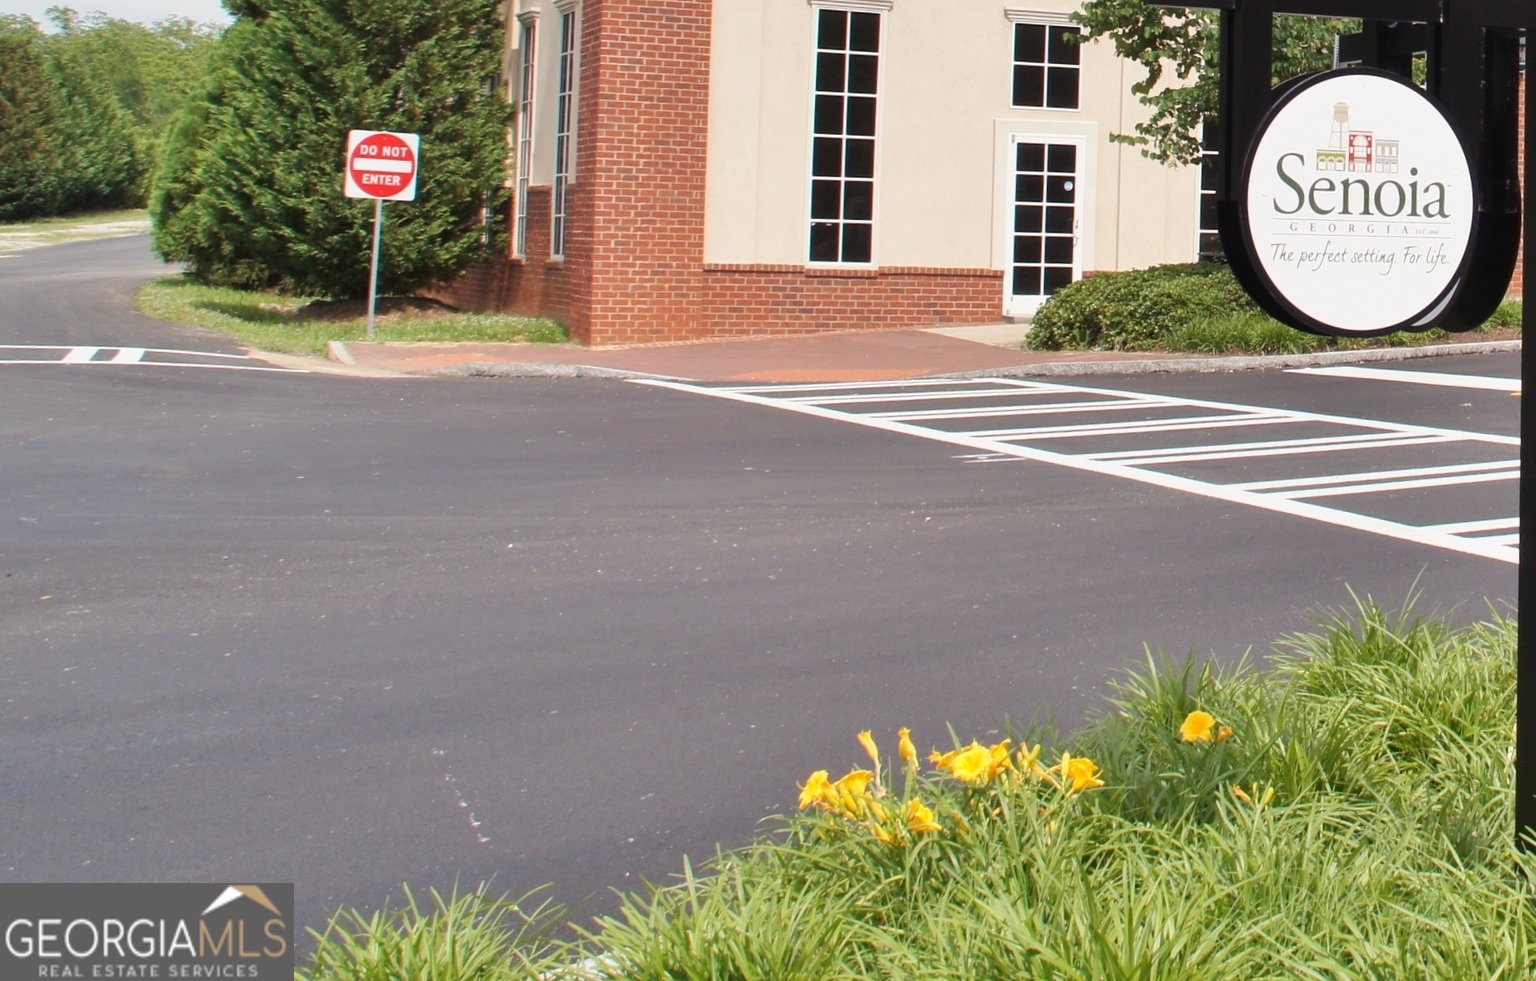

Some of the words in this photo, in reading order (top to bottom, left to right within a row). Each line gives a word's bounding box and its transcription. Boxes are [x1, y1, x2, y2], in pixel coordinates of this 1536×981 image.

[360, 144, 378, 156] DO
[382, 146, 408, 158] NOT
[362, 173, 402, 187] ENTER
[1272, 152, 1451, 220] Senoia
[1271, 243, 1295, 262] The
[1296, 240, 1348, 272] perfect
[1350, 248, 1397, 276] setting.
[1403, 246, 1423, 264] For
[1425, 242, 1450, 274] life.
